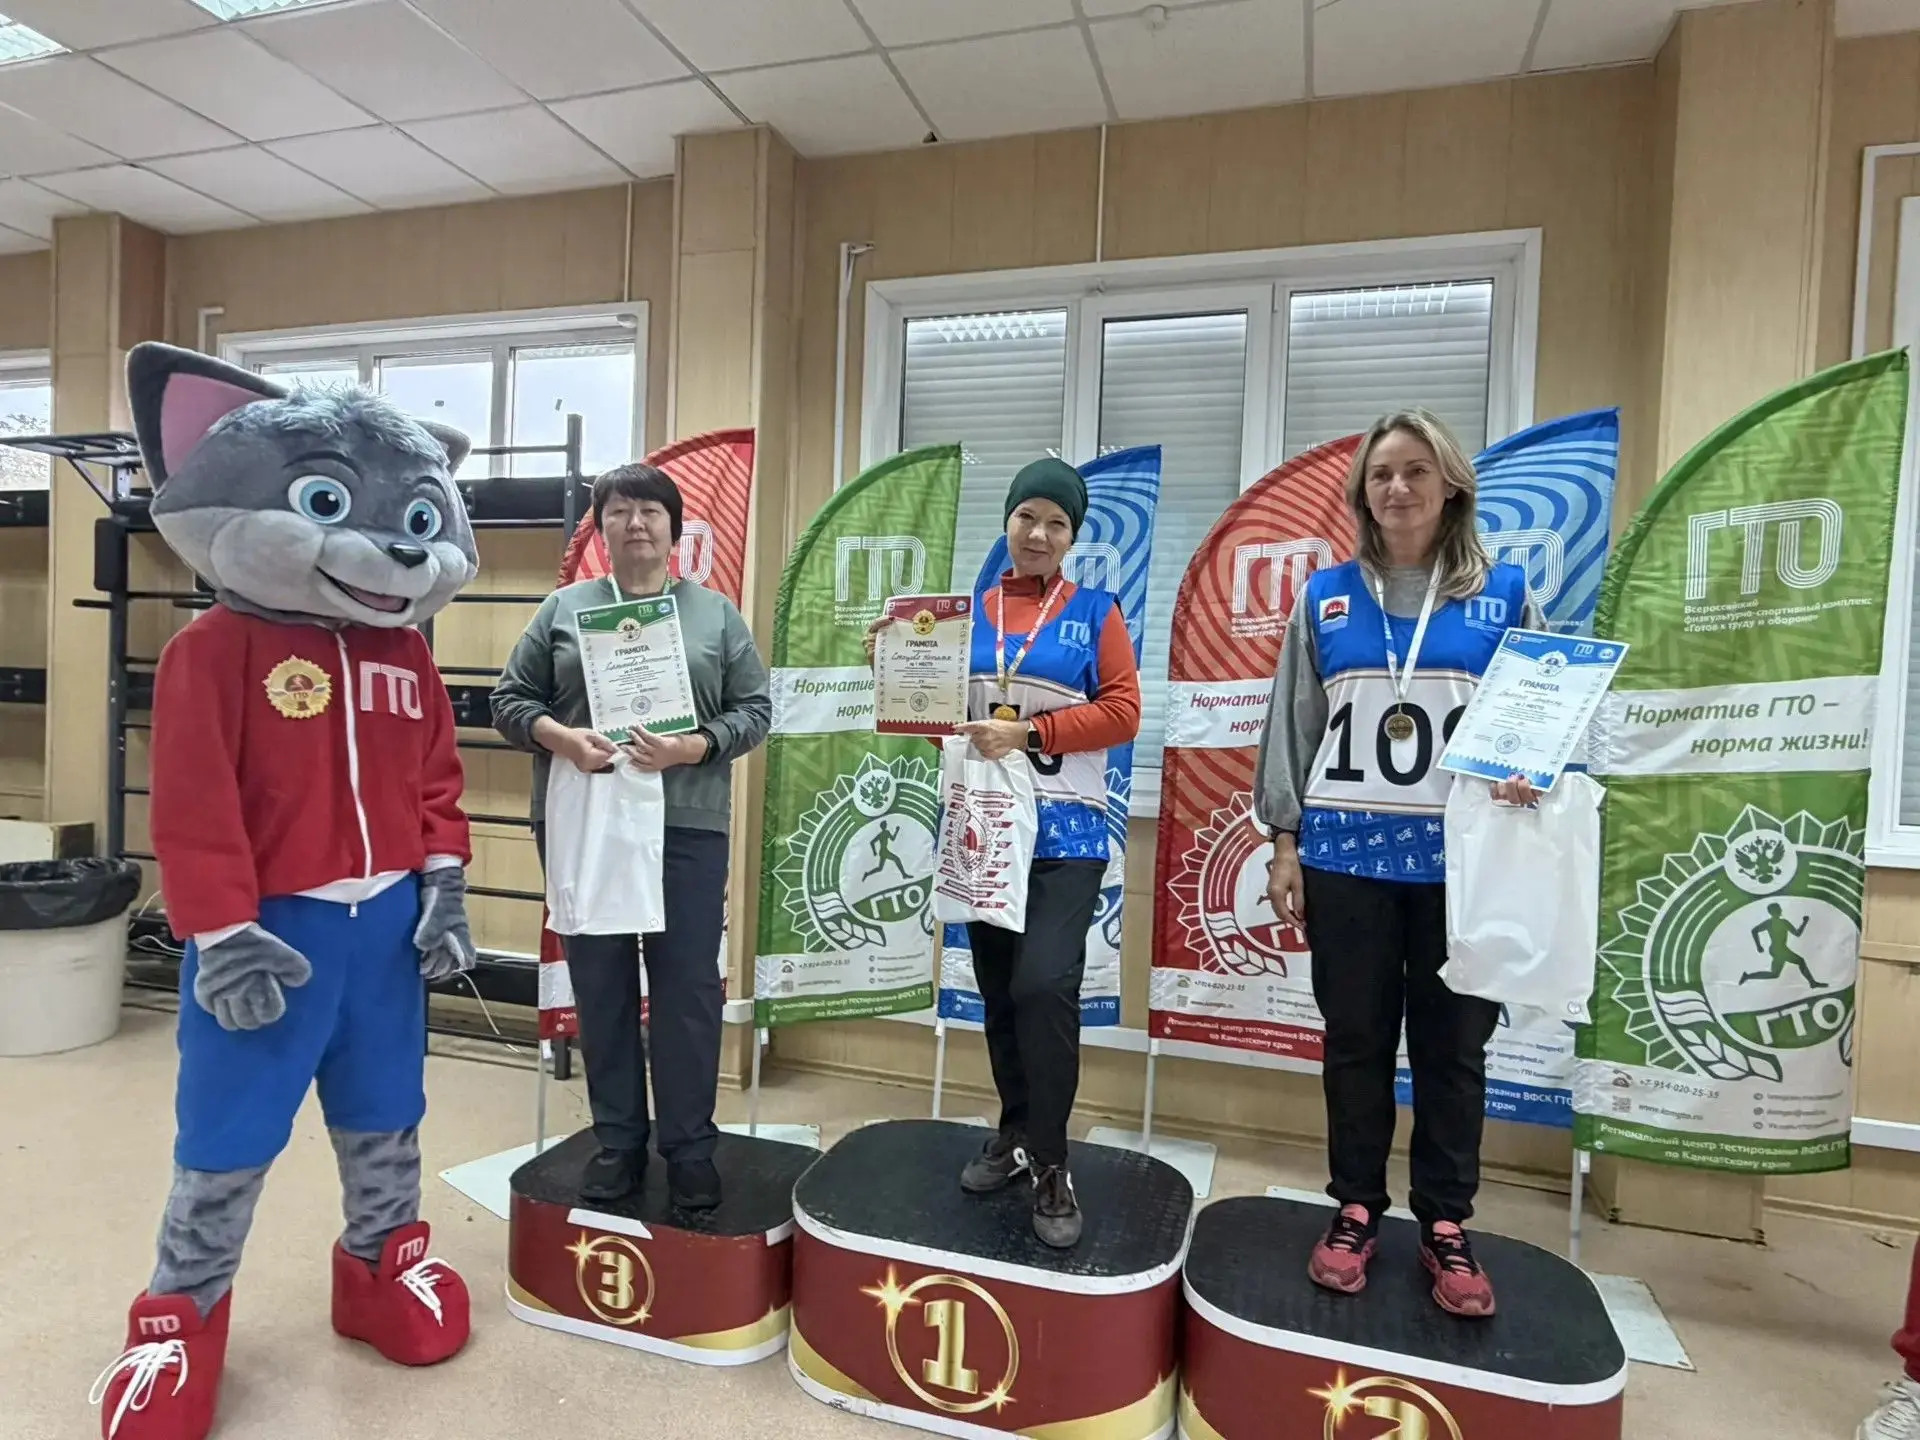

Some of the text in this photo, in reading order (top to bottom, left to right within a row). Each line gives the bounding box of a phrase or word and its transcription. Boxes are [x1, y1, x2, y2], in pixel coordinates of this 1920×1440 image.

[1685, 498, 1842, 600] ГТО
[836, 536, 926, 600] ГТО
[615, 645, 651, 656] ГРАМОТА
[905, 640, 938, 648] ГРАМОТА
[360, 661, 424, 720] ГТО
[1518, 679, 1560, 692] ГРАМОТА
[837, 703, 873, 718] норм
[1624, 703, 1760, 728] Норматив
[1768, 695, 1815, 717] ГТО
[1325, 702, 1468, 787] 10
[1690, 728, 1868, 757] норма жизни!
[868, 885, 924, 919] ГТО
[1270, 924, 1304, 949] ГТ
[1756, 998, 1845, 1046] ГТО
[1523, 1091, 1552, 1103] ВФСК
[395, 1236, 425, 1267] ГТО
[597, 1251, 636, 1310] 3
[138, 1314, 181, 1335] ГТО
[923, 1299, 978, 1395] 1
